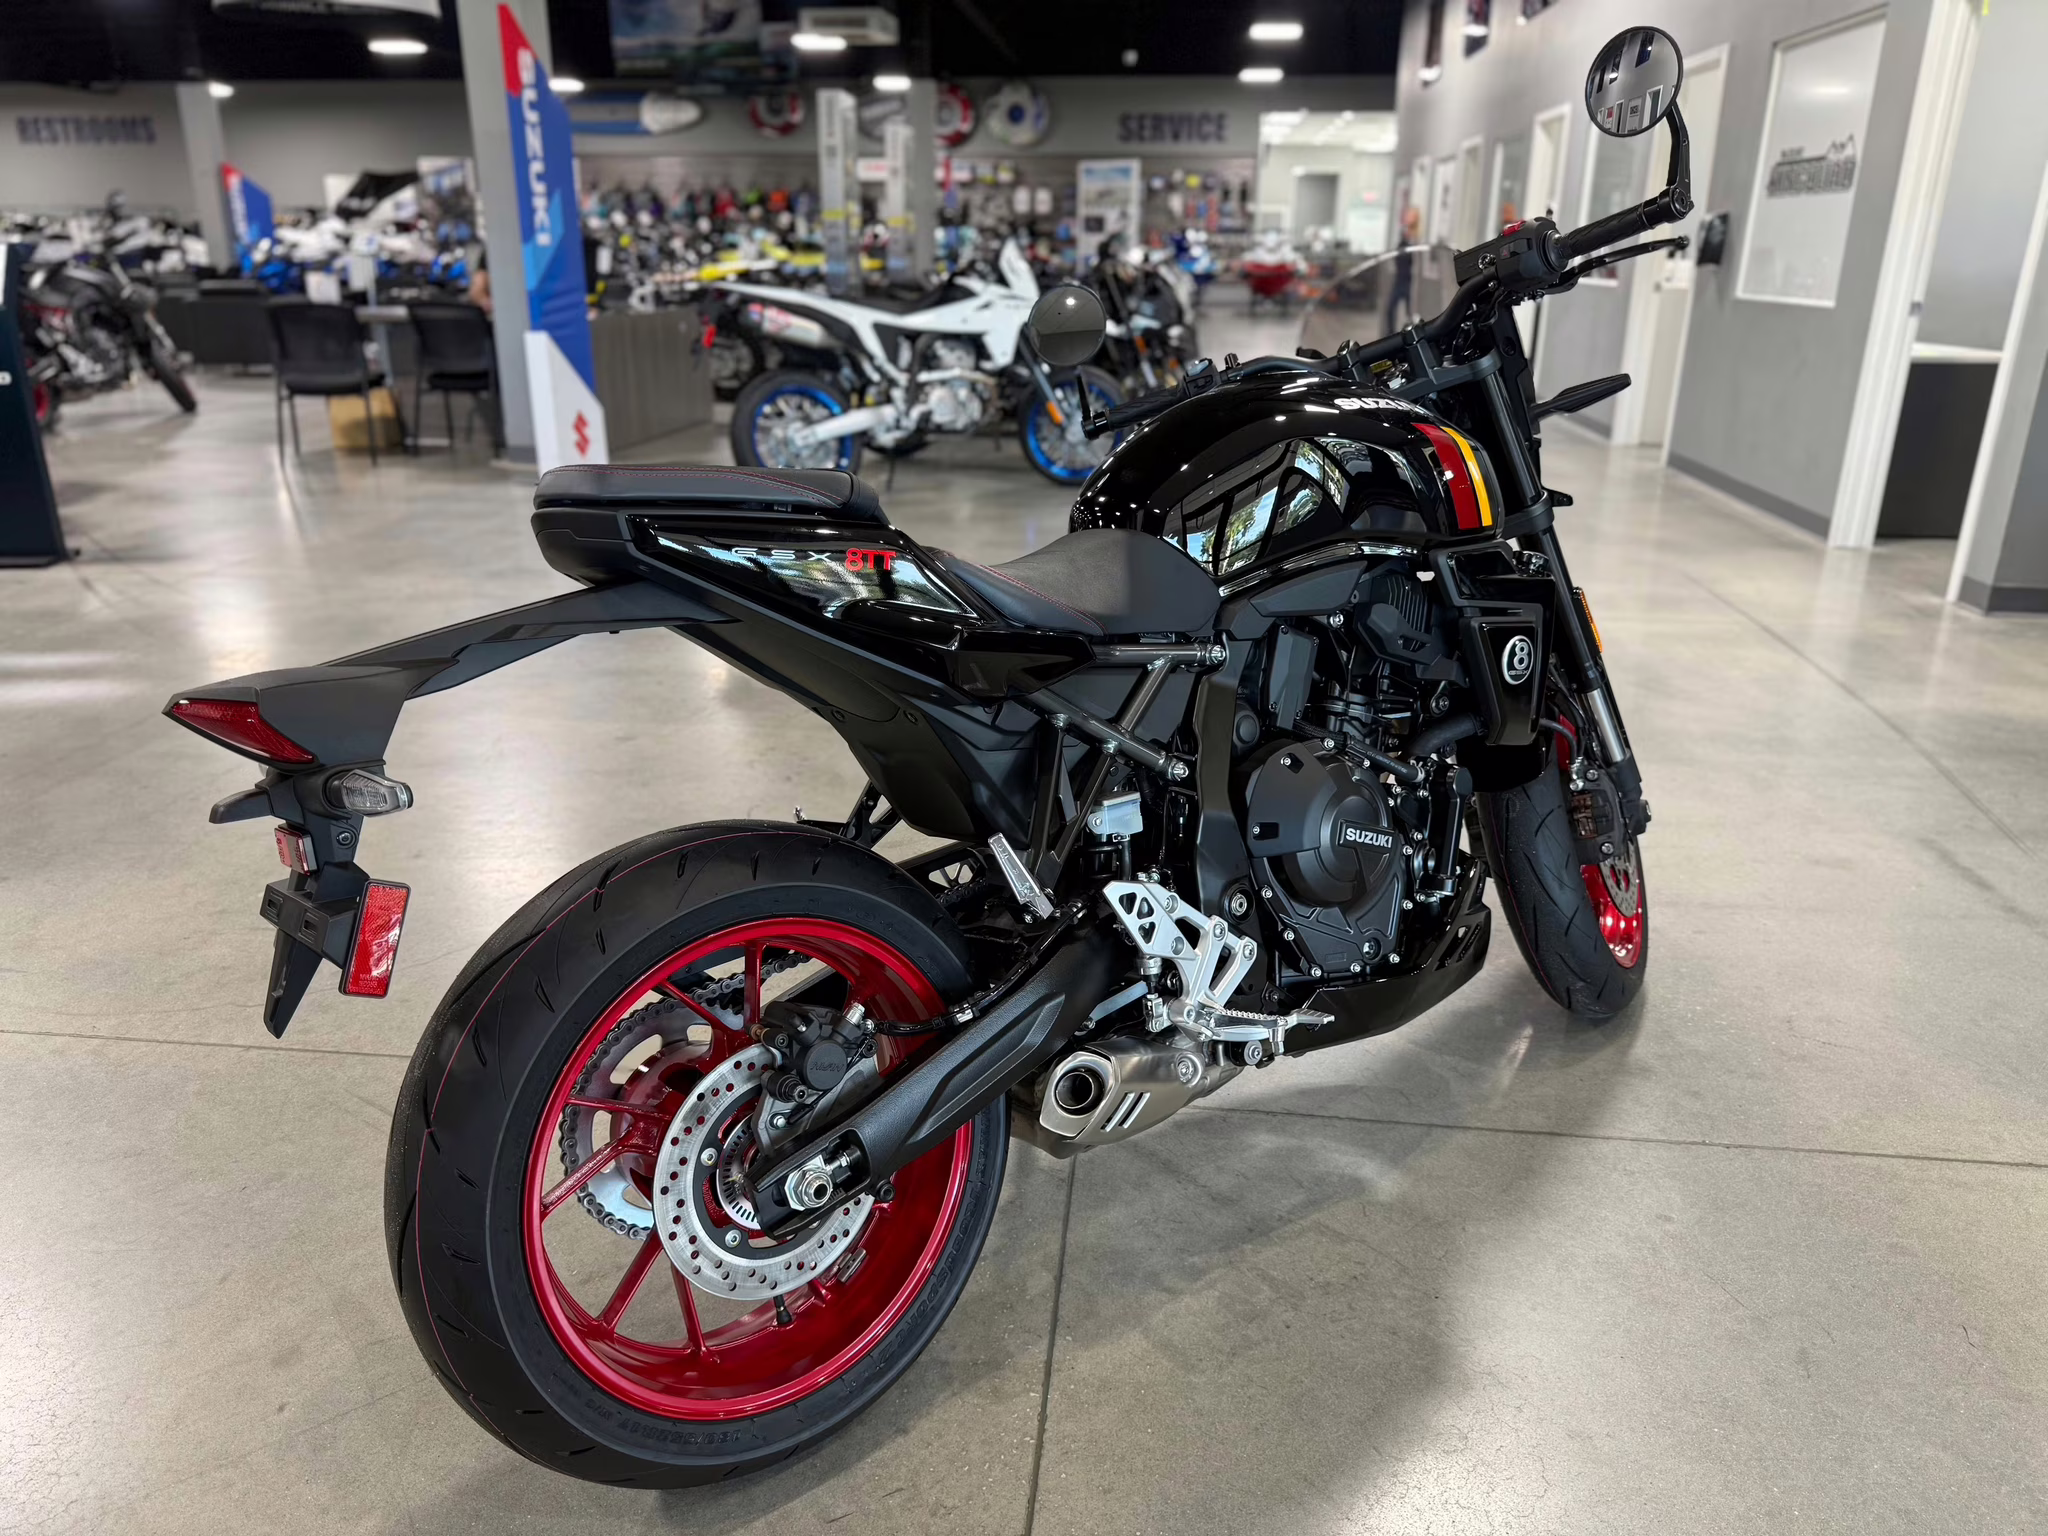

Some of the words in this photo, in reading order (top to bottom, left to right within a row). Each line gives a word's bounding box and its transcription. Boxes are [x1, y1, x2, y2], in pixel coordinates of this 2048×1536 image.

[1118, 111, 1227, 143] SERVICE
[517, 47, 552, 246] SUZUKI
[1334, 397, 1424, 414] SUZU
[845, 547, 897, 571] 8TT
[1513, 641, 1529, 670] 8
[1345, 827, 1393, 848] SUZUKI
